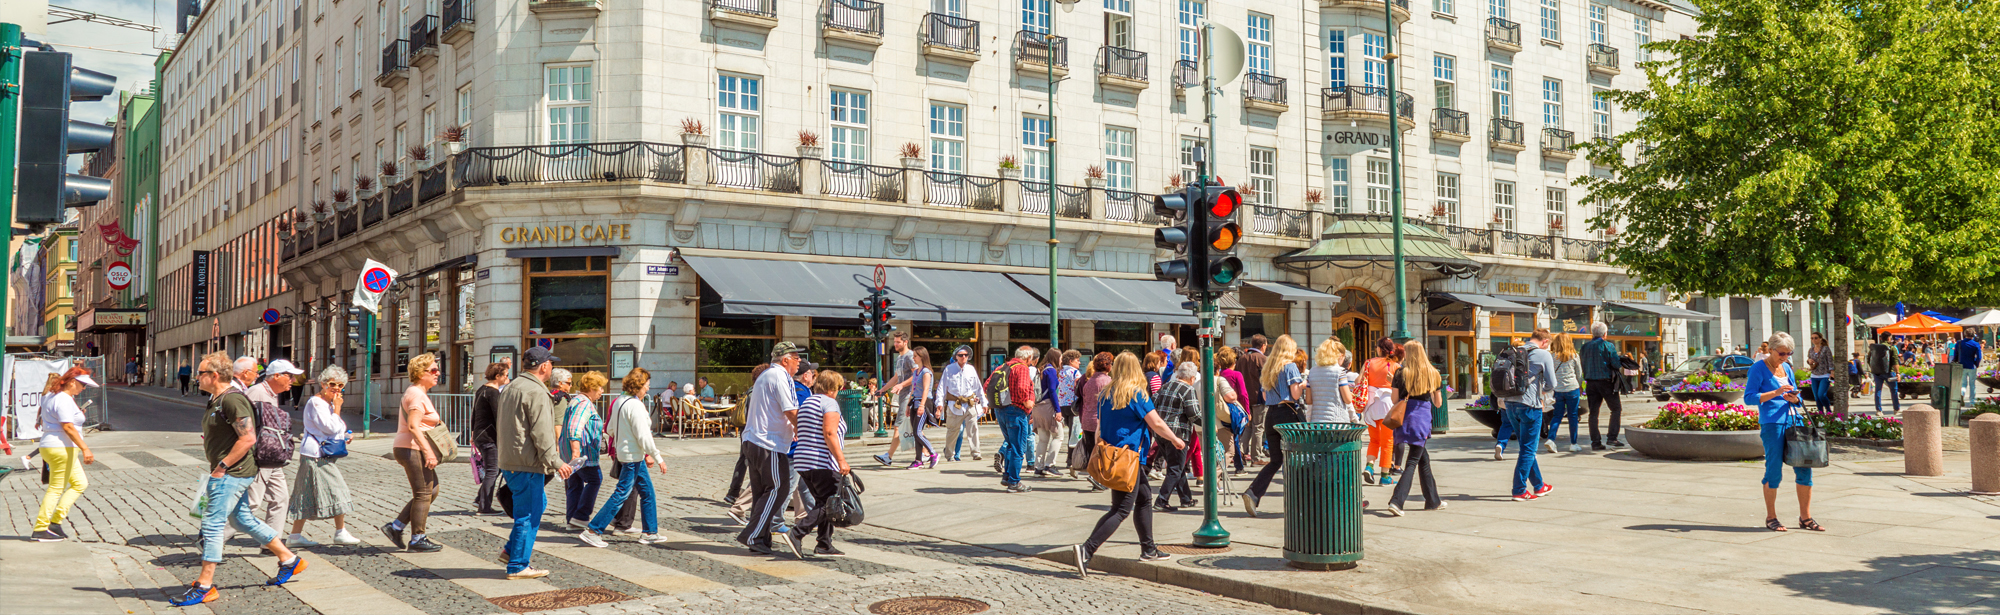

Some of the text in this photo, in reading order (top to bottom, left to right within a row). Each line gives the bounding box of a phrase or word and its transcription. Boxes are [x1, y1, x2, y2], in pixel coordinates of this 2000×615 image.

[1334, 131, 1379, 145] GRAND
[500, 223, 631, 243] GRAND CAFE
[198, 254, 206, 287] MØBLER
[1498, 281, 1530, 294] BJERKE
[1621, 290, 1648, 301] BJERKE
[1780, 300, 1793, 315] DNB
[1437, 315, 1464, 329] Bjerke
